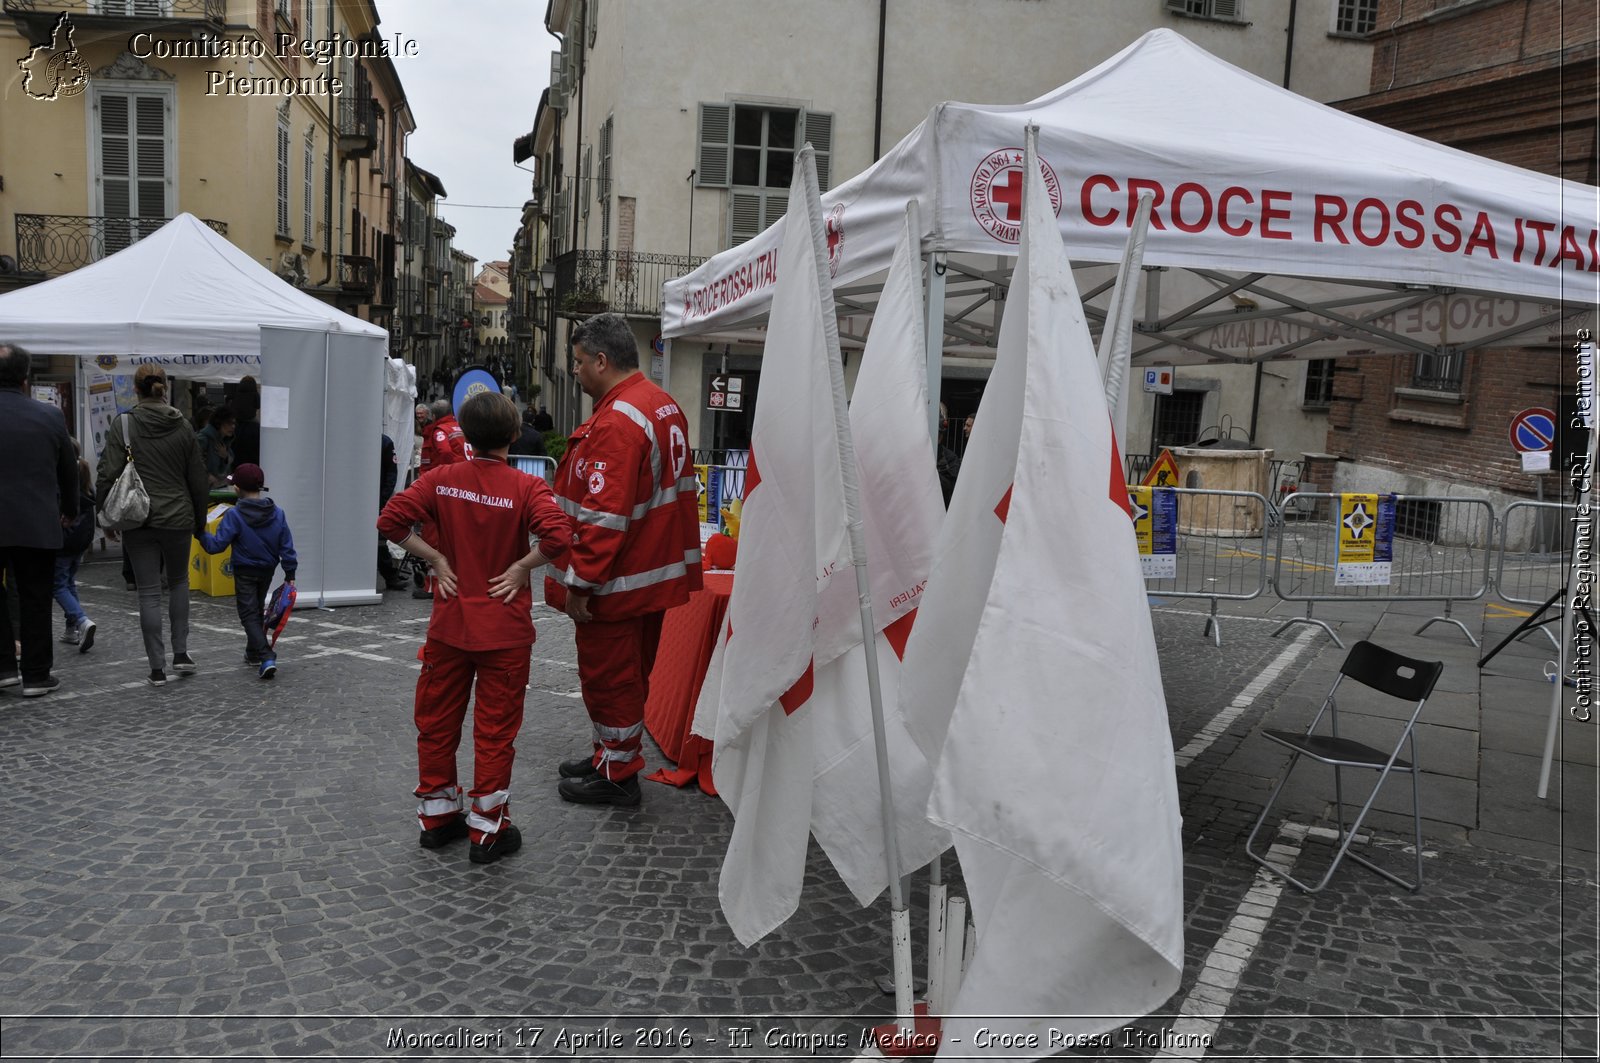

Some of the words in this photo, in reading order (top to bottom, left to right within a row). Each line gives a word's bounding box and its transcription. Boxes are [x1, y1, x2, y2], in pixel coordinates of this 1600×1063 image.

[974, 168, 991, 209] AGOSTO
[987, 152, 1010, 171] 1864
[1080, 173, 1293, 240] CROCE
[1313, 194, 1499, 260] ROSSA
[692, 282, 719, 318] CROCE
[720, 263, 753, 306] ROSSA
[130, 355, 170, 365] LIONS
[173, 354, 210, 365] CLUB
[436, 485, 458, 498] CROCE
[459, 490, 480, 503] ROSSA
[481, 494, 513, 509] ITALIANA
